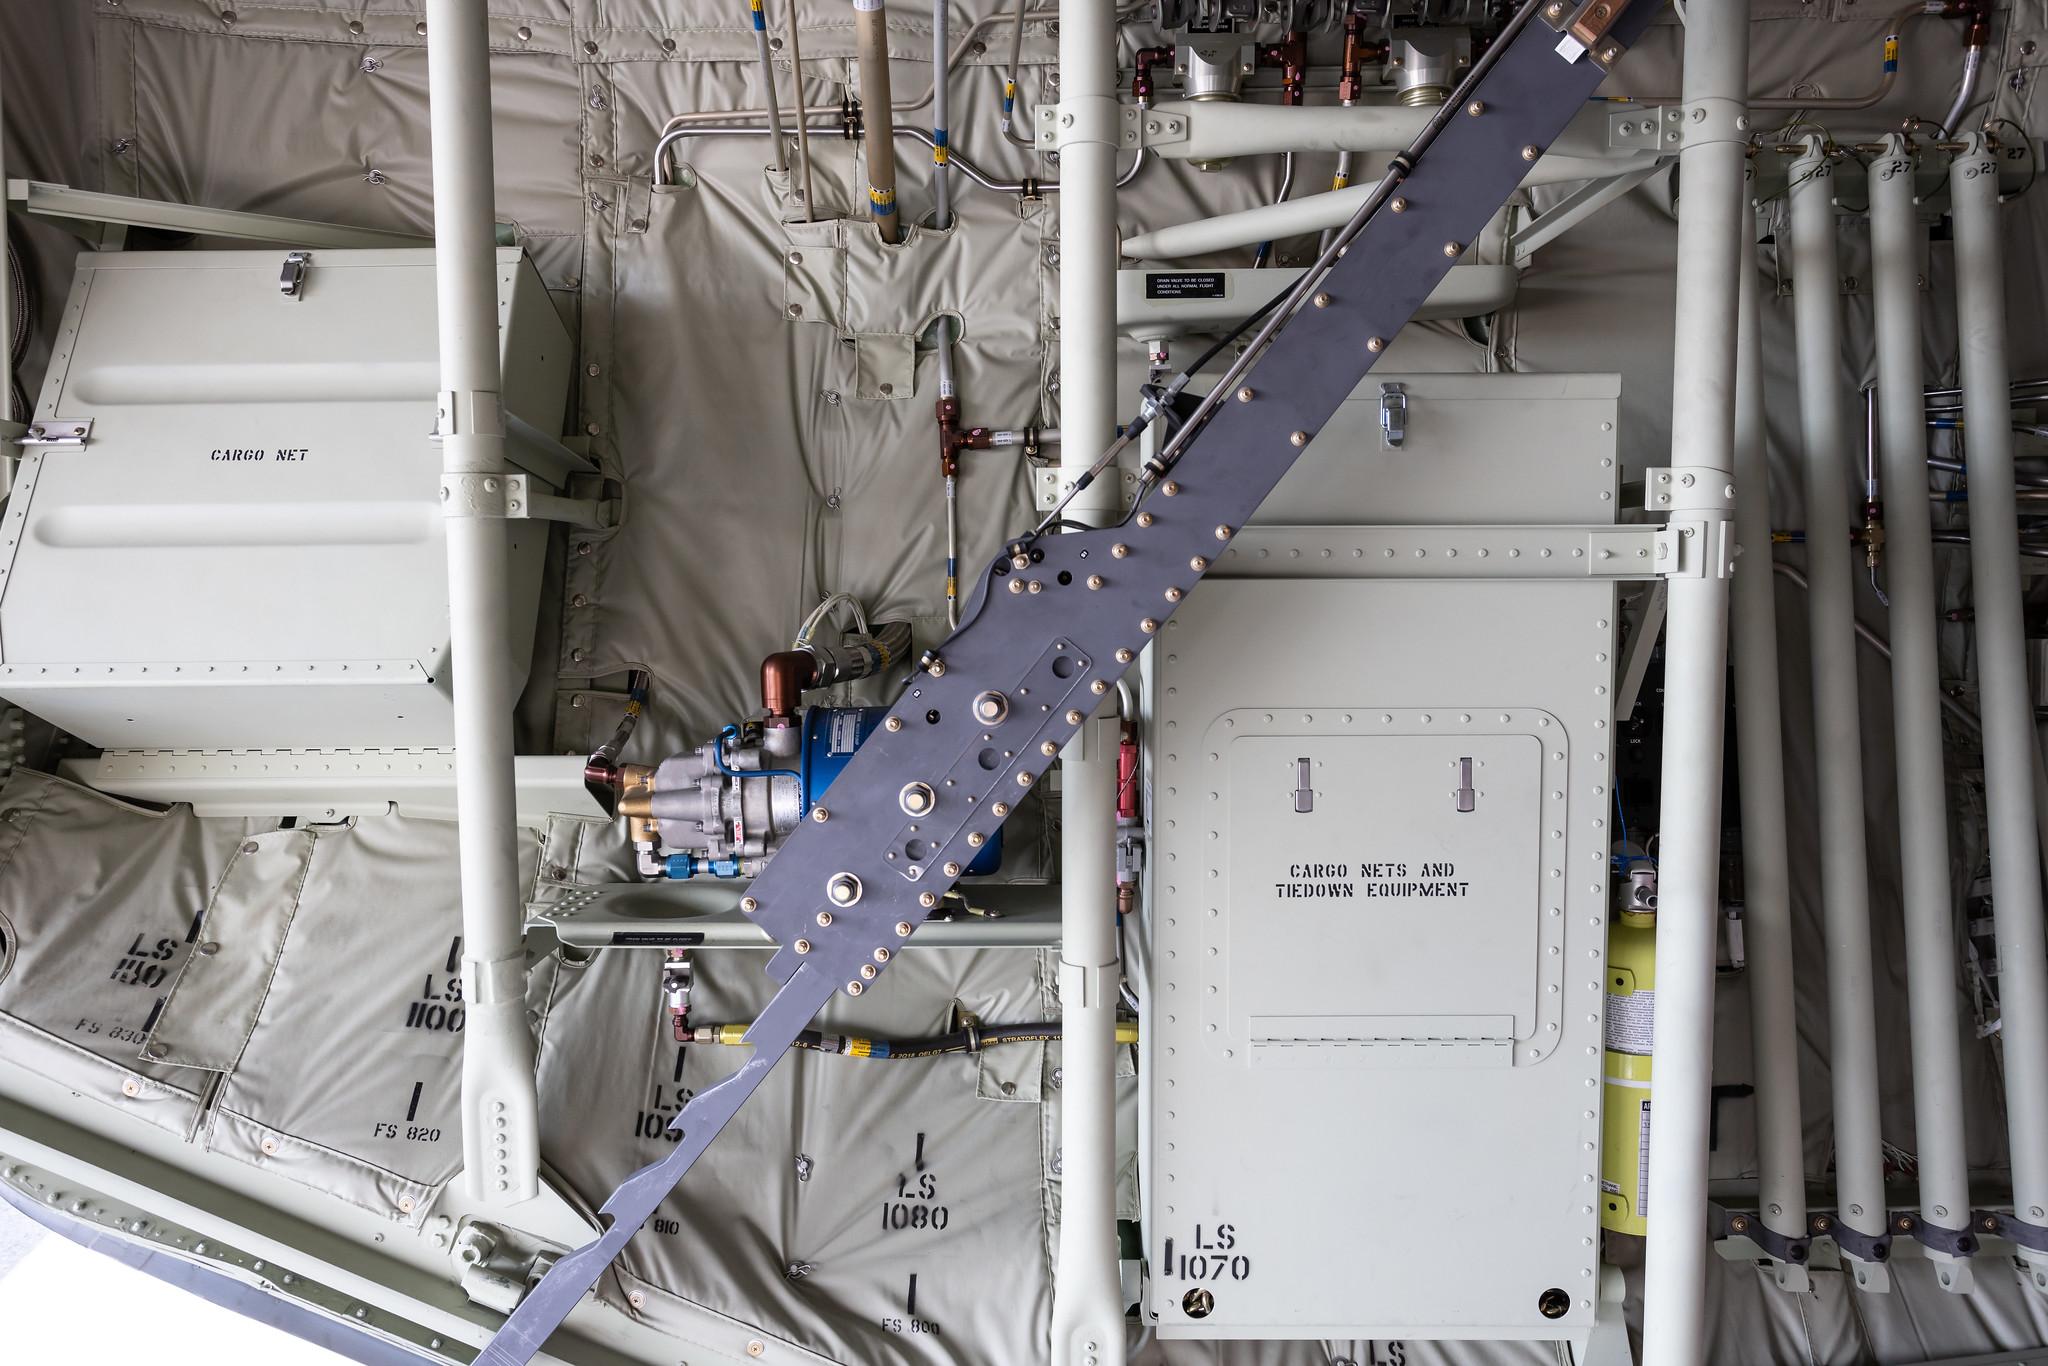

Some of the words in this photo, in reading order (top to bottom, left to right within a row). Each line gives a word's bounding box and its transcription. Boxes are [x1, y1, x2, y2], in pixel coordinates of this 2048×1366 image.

[2008, 147, 2026, 159] 27
[1745, 169, 1752, 181] 7
[1816, 165, 1832, 177] 27
[1893, 160, 1911, 173] 27
[1981, 162, 1998, 174] 27
[211, 449, 264, 461] CARGO
[276, 449, 309, 461] NET
[1290, 864, 1348, 878] CARGO
[1361, 863, 1407, 878] NETS
[1421, 863, 1455, 877] AND
[1275, 883, 1353, 898] TIEDOWN
[1367, 882, 1469, 897] EQUIPMENT
[127, 933, 178, 961] LS
[424, 974, 462, 1002] LS
[406, 1002, 465, 1032] 1100
[75, 1018, 102, 1035] FS
[108, 1026, 147, 1045] 830
[1002, 1035, 1050, 1043] STRATOFLEX
[655, 1085, 694, 1112] LS
[374, 1123, 398, 1139] FS
[406, 1126, 441, 1142] 820
[898, 1173, 936, 1200] LS
[882, 1202, 949, 1230] 1080
[654, 1219, 680, 1235] 810
[1196, 1224, 1235, 1250] LS
[1180, 1254, 1250, 1281] 1070
[882, 1318, 902, 1333] FS
[911, 1319, 940, 1335] 800
